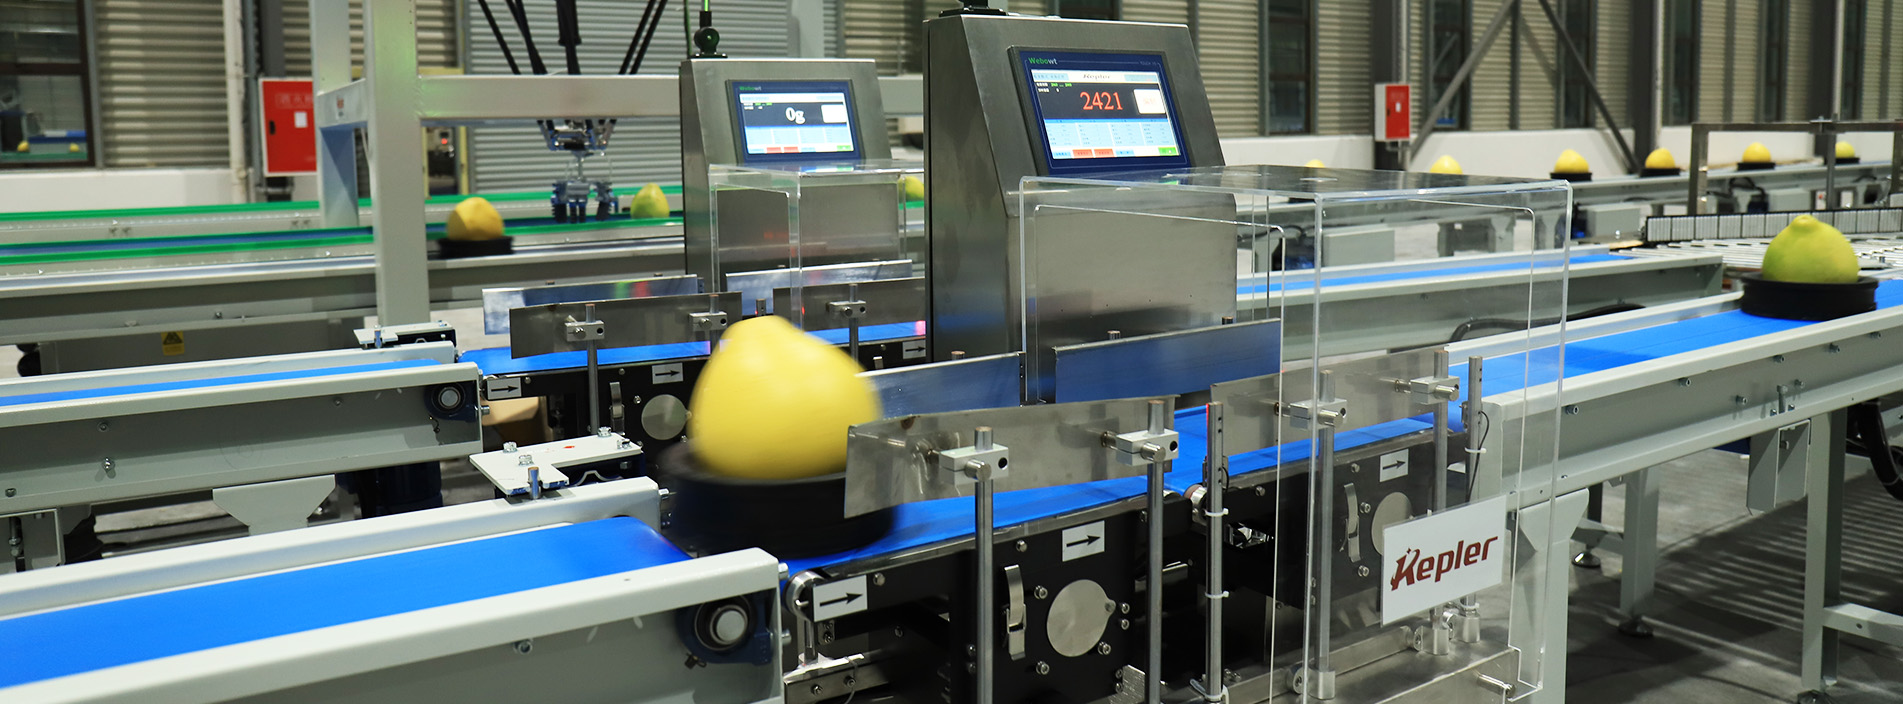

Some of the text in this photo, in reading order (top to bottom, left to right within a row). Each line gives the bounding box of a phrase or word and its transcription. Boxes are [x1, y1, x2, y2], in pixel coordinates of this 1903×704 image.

[1080, 91, 1123, 110] 2421
[785, 107, 805, 124] 0g
[1390, 536, 1498, 591] Kepler
